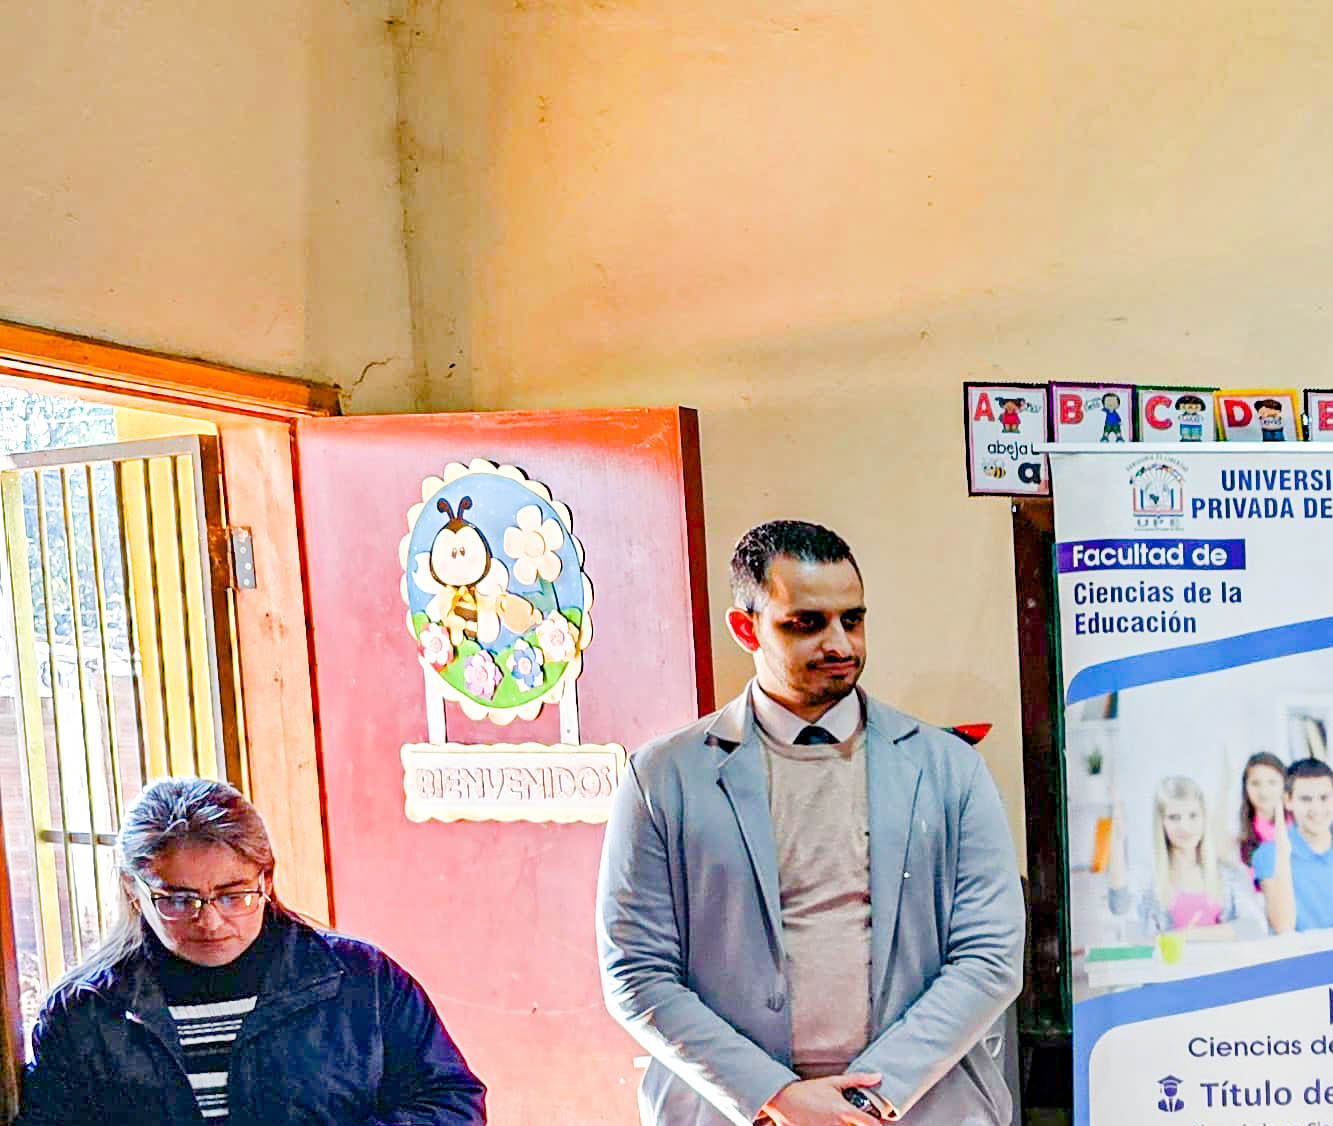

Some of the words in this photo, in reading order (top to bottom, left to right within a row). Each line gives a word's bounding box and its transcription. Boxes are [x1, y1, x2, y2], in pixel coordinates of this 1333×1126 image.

[974, 393, 994, 421] A
[1059, 393, 1083, 424] B
[1146, 396, 1172, 429] C
[1223, 400, 1252, 428] D
[987, 442, 1027, 460] abeja
[1192, 498, 1294, 519] PRIVADA
[1073, 544, 1185, 567] Facultad
[1193, 545, 1227, 566] de
[1074, 582, 1174, 605] Ciencias
[1183, 581, 1211, 604] de
[1221, 580, 1241, 603] la
[1075, 610, 1196, 635] Educación
[416, 766, 612, 799] BIENVENIDOS
[1188, 1035, 1301, 1058] Ciencias
[1200, 1079, 1292, 1107] Título
